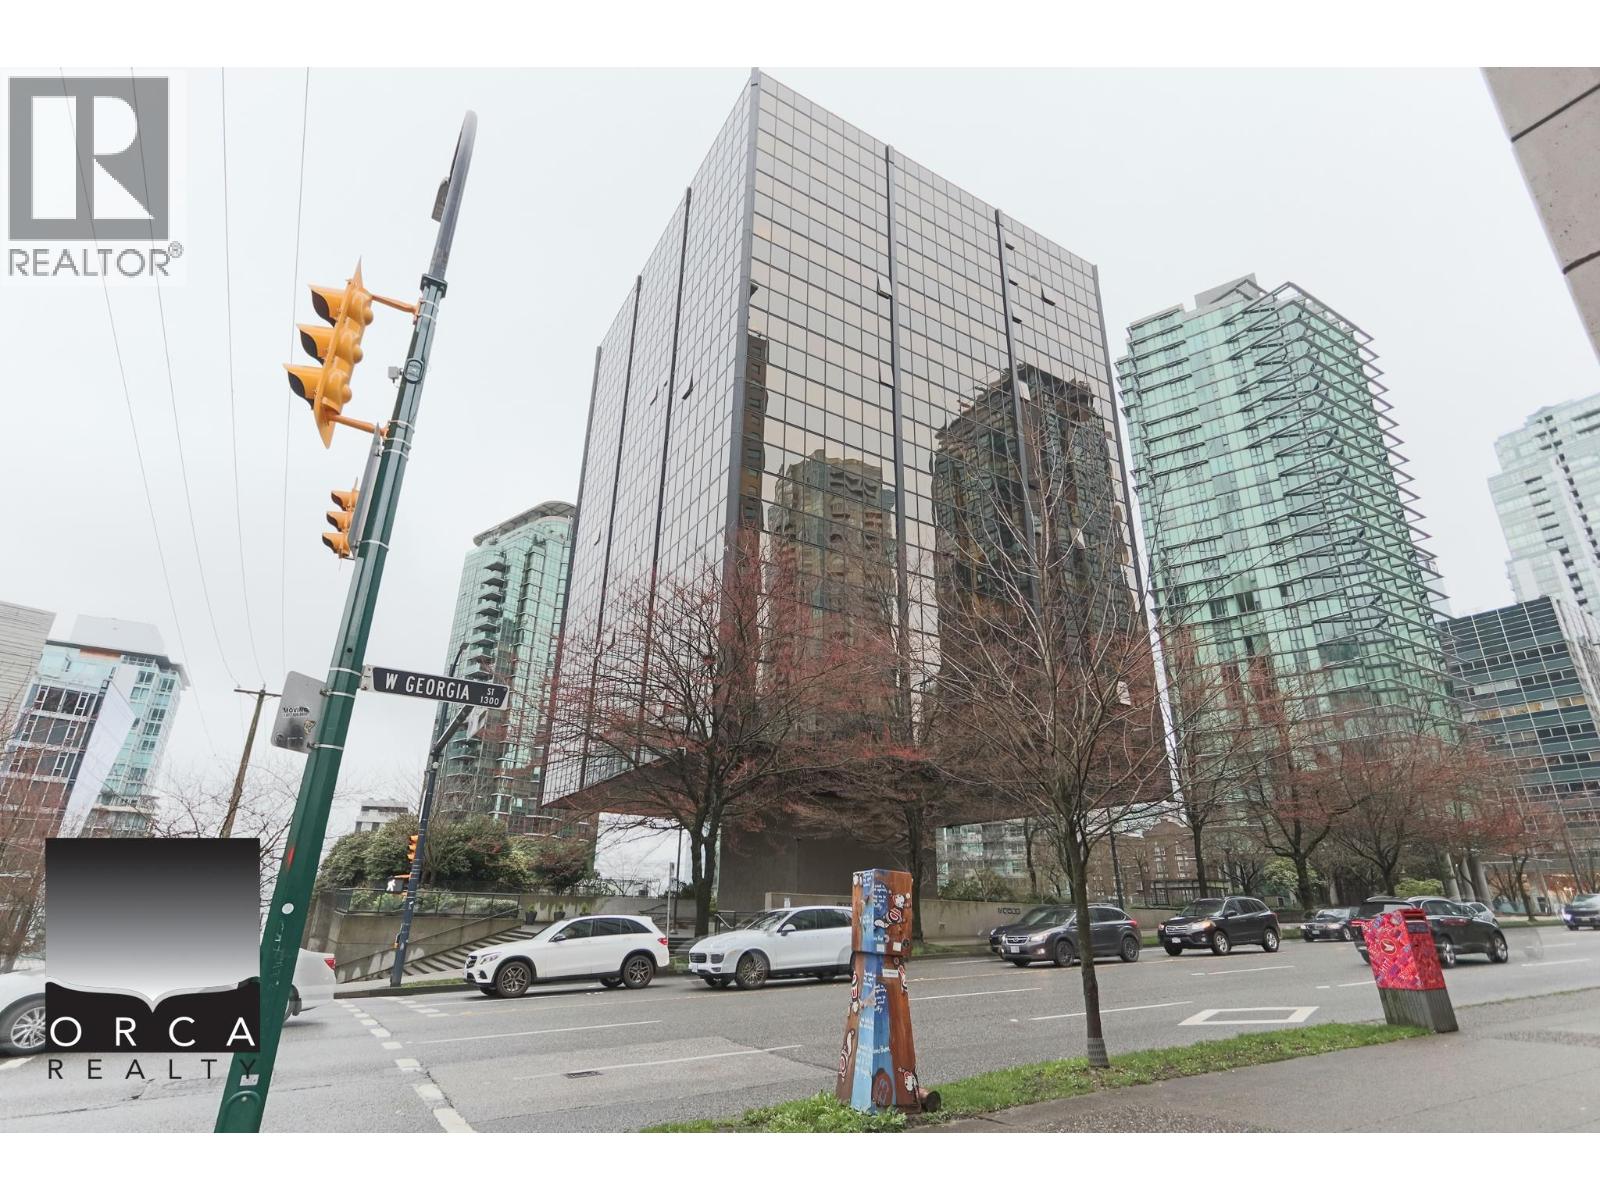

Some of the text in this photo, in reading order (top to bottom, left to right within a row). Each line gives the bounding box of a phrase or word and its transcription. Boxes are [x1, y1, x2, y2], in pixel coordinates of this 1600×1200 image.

[385, 672, 470, 701] W GEORGIA
[486, 687, 495, 696] ST
[480, 696, 500, 706] 1300
